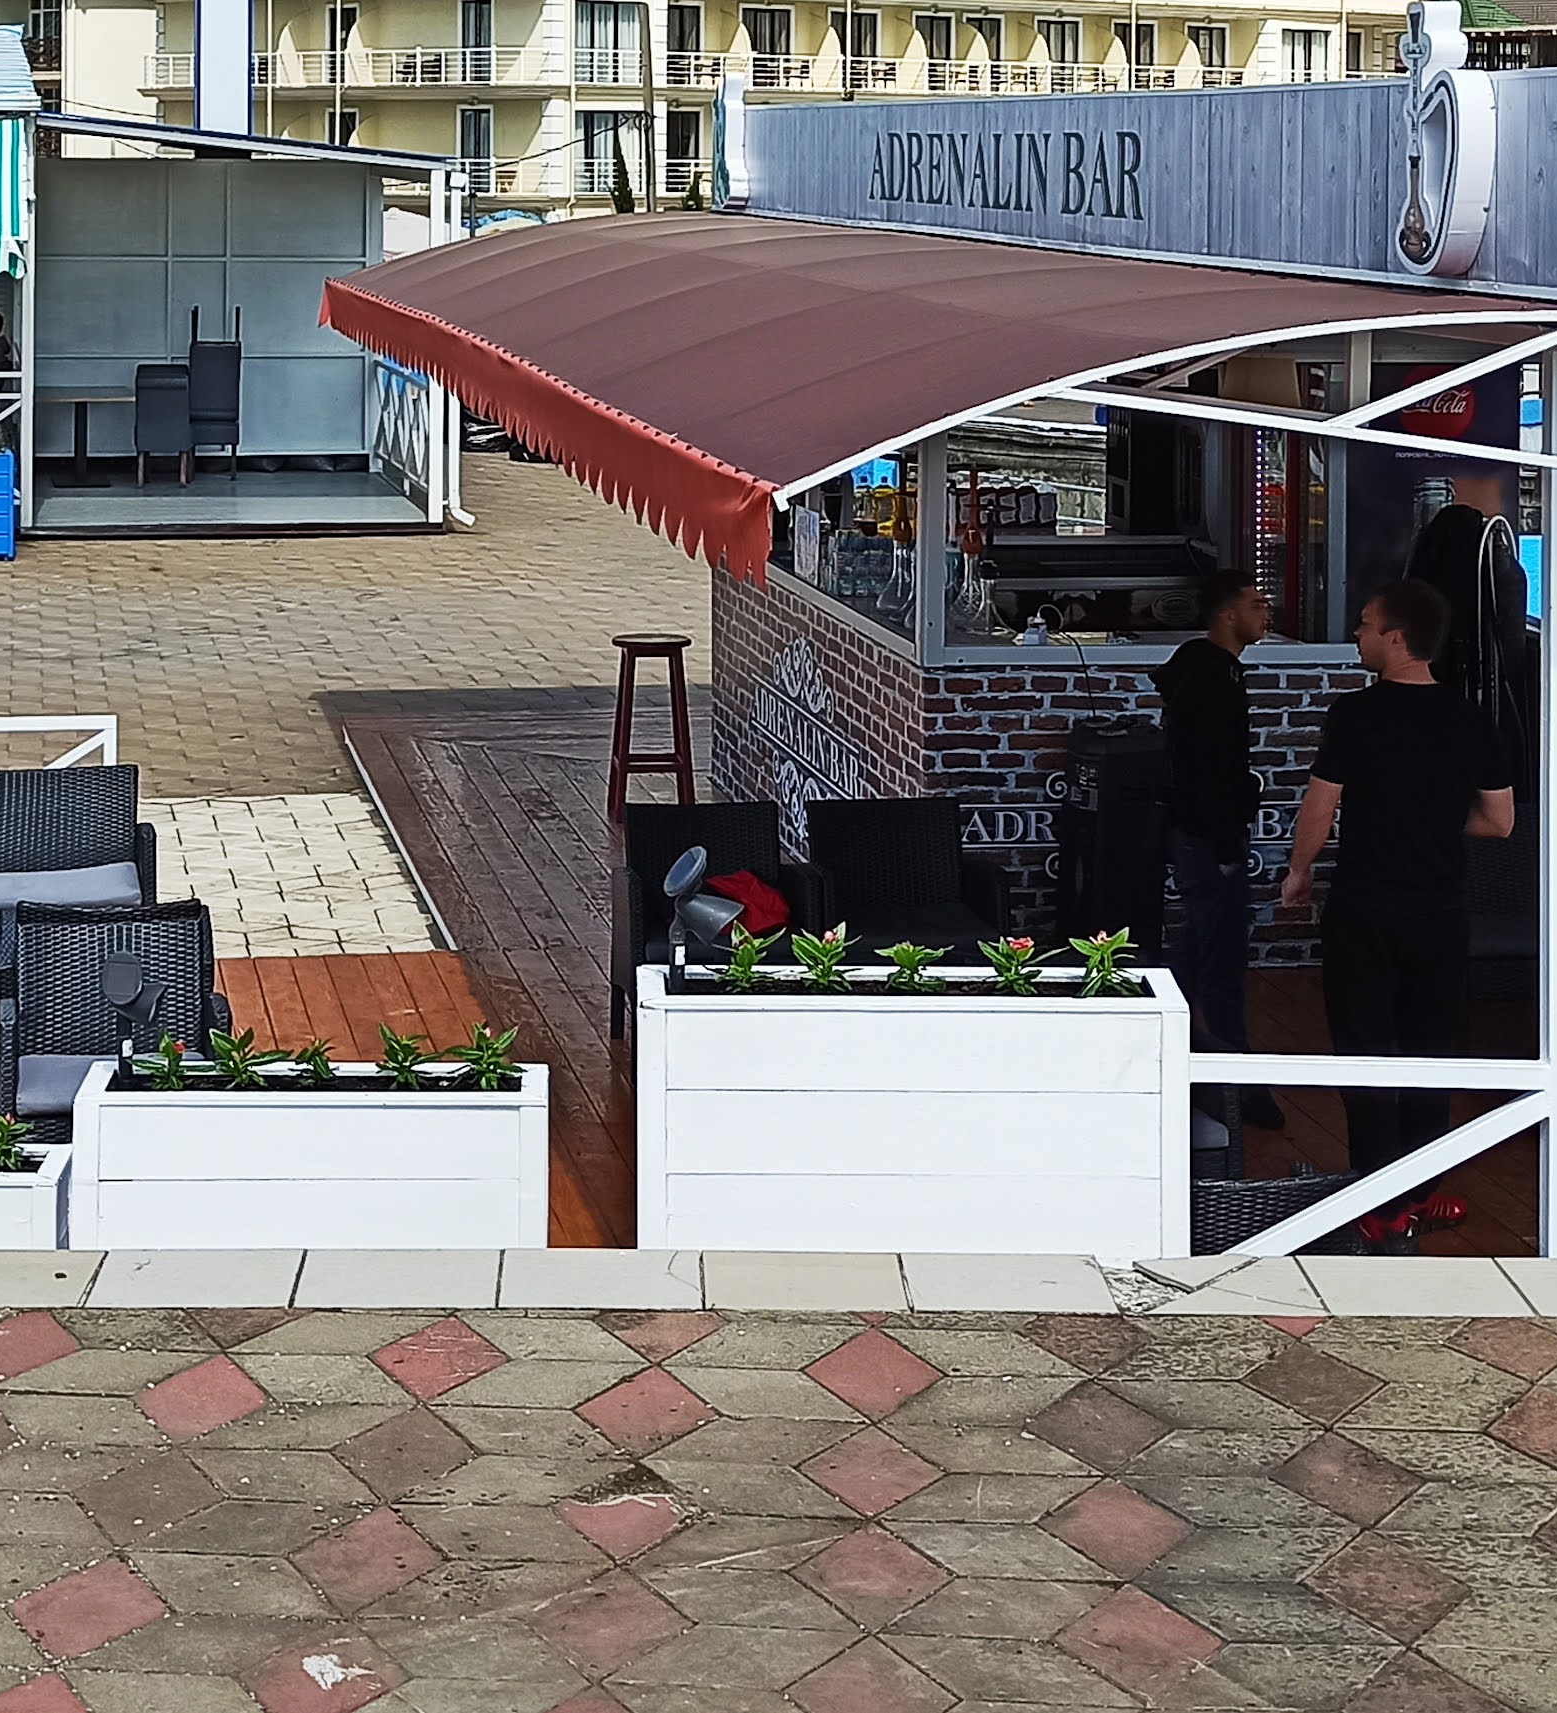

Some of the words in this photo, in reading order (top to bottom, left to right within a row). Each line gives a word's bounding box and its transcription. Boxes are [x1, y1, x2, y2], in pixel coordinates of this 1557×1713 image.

[868, 131, 1052, 214] ADRENALIN
[1060, 130, 1144, 221] BAR
[751, 684, 830, 773] ADRENALIN
[830, 740, 865, 800] BAR
